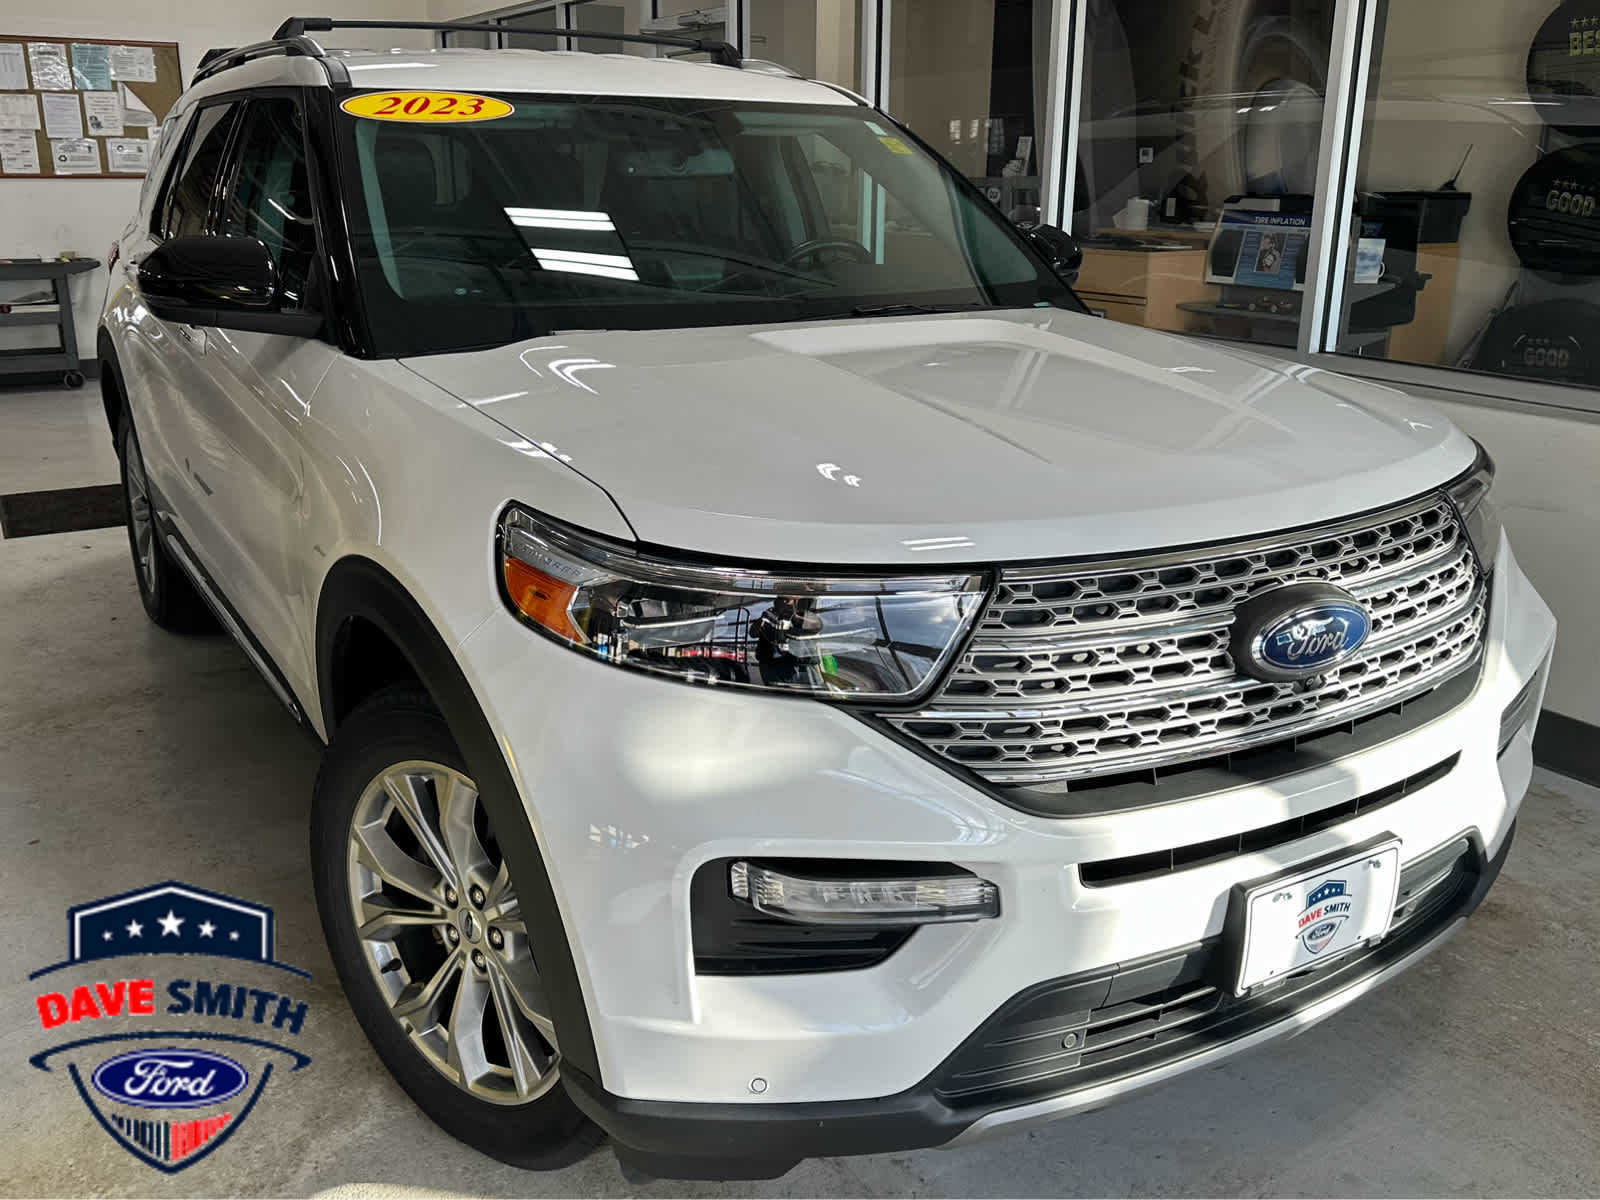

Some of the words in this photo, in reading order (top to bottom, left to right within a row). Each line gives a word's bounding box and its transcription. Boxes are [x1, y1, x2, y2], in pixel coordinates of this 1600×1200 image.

[373, 96, 485, 116] 2023
[1546, 189, 1596, 216] GOOD
[1255, 216, 1269, 225] TIRE
[1270, 216, 1306, 226] INFLATION
[1523, 347, 1569, 367] GOOD
[1285, 616, 1350, 660] Ford
[1298, 908, 1323, 928] DAVE
[1324, 902, 1351, 915] SMITH
